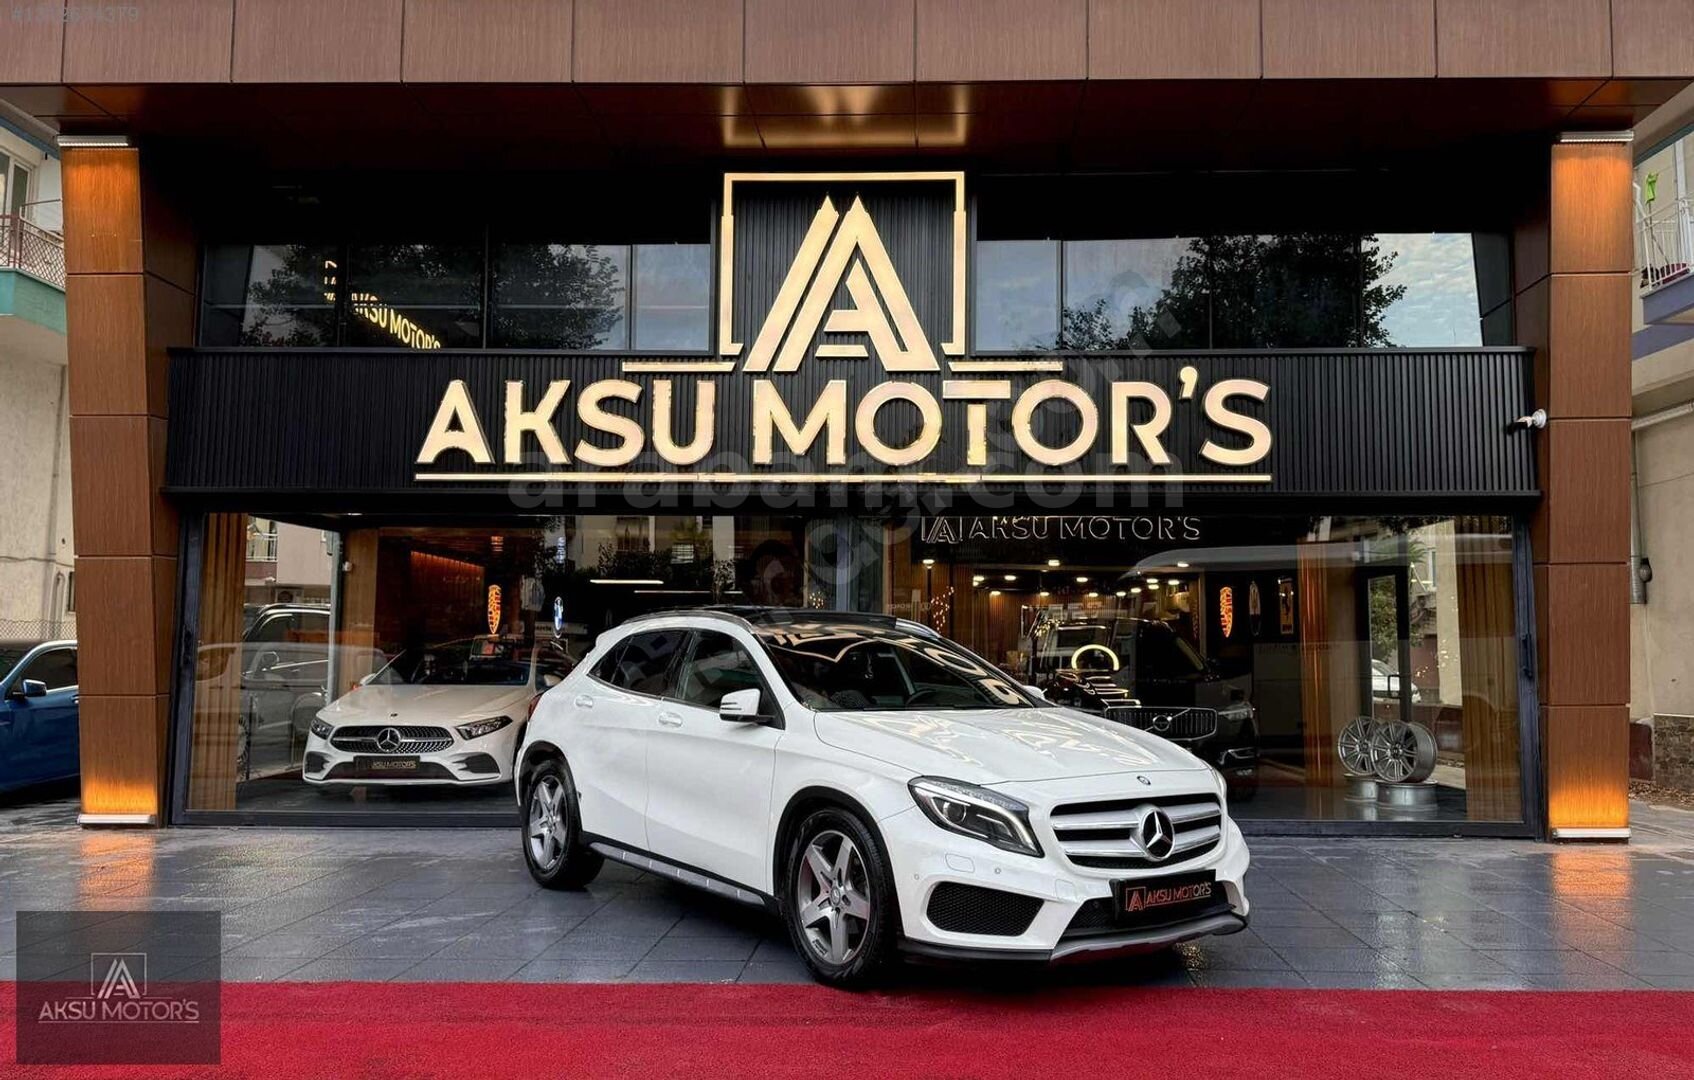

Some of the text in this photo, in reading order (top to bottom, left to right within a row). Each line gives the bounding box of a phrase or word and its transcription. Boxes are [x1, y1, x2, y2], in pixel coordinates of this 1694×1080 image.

[414, 365, 1274, 467] AKSU MOTOR'S
[968, 516, 1049, 540] AKSU
[1059, 516, 1201, 541] MOTOR'S
[1146, 888, 1171, 905] AKSU
